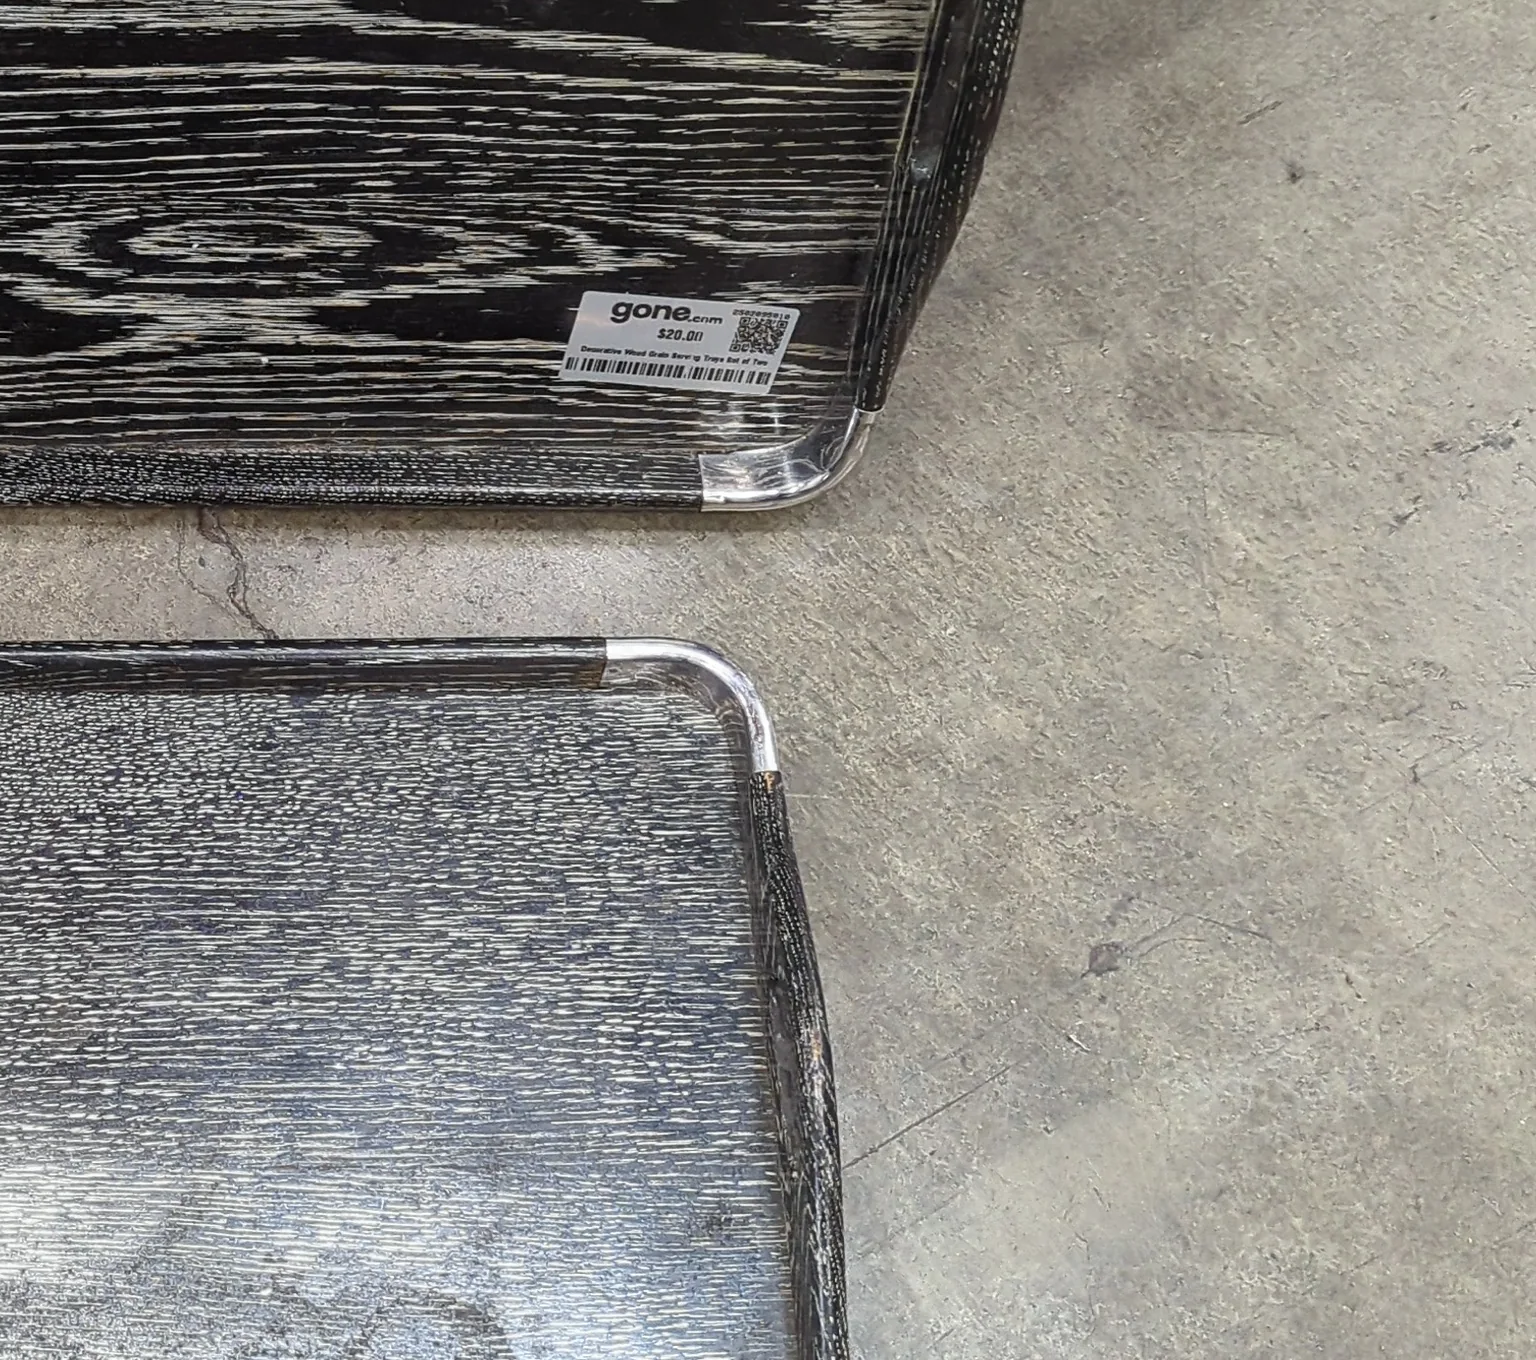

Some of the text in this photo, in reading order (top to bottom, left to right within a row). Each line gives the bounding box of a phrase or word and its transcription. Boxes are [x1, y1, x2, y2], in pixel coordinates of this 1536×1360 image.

[610, 301, 723, 324] gone.com
[657, 328, 704, 342] $20.00
[625, 349, 647, 357] Wood
[752, 359, 768, 367] Two
